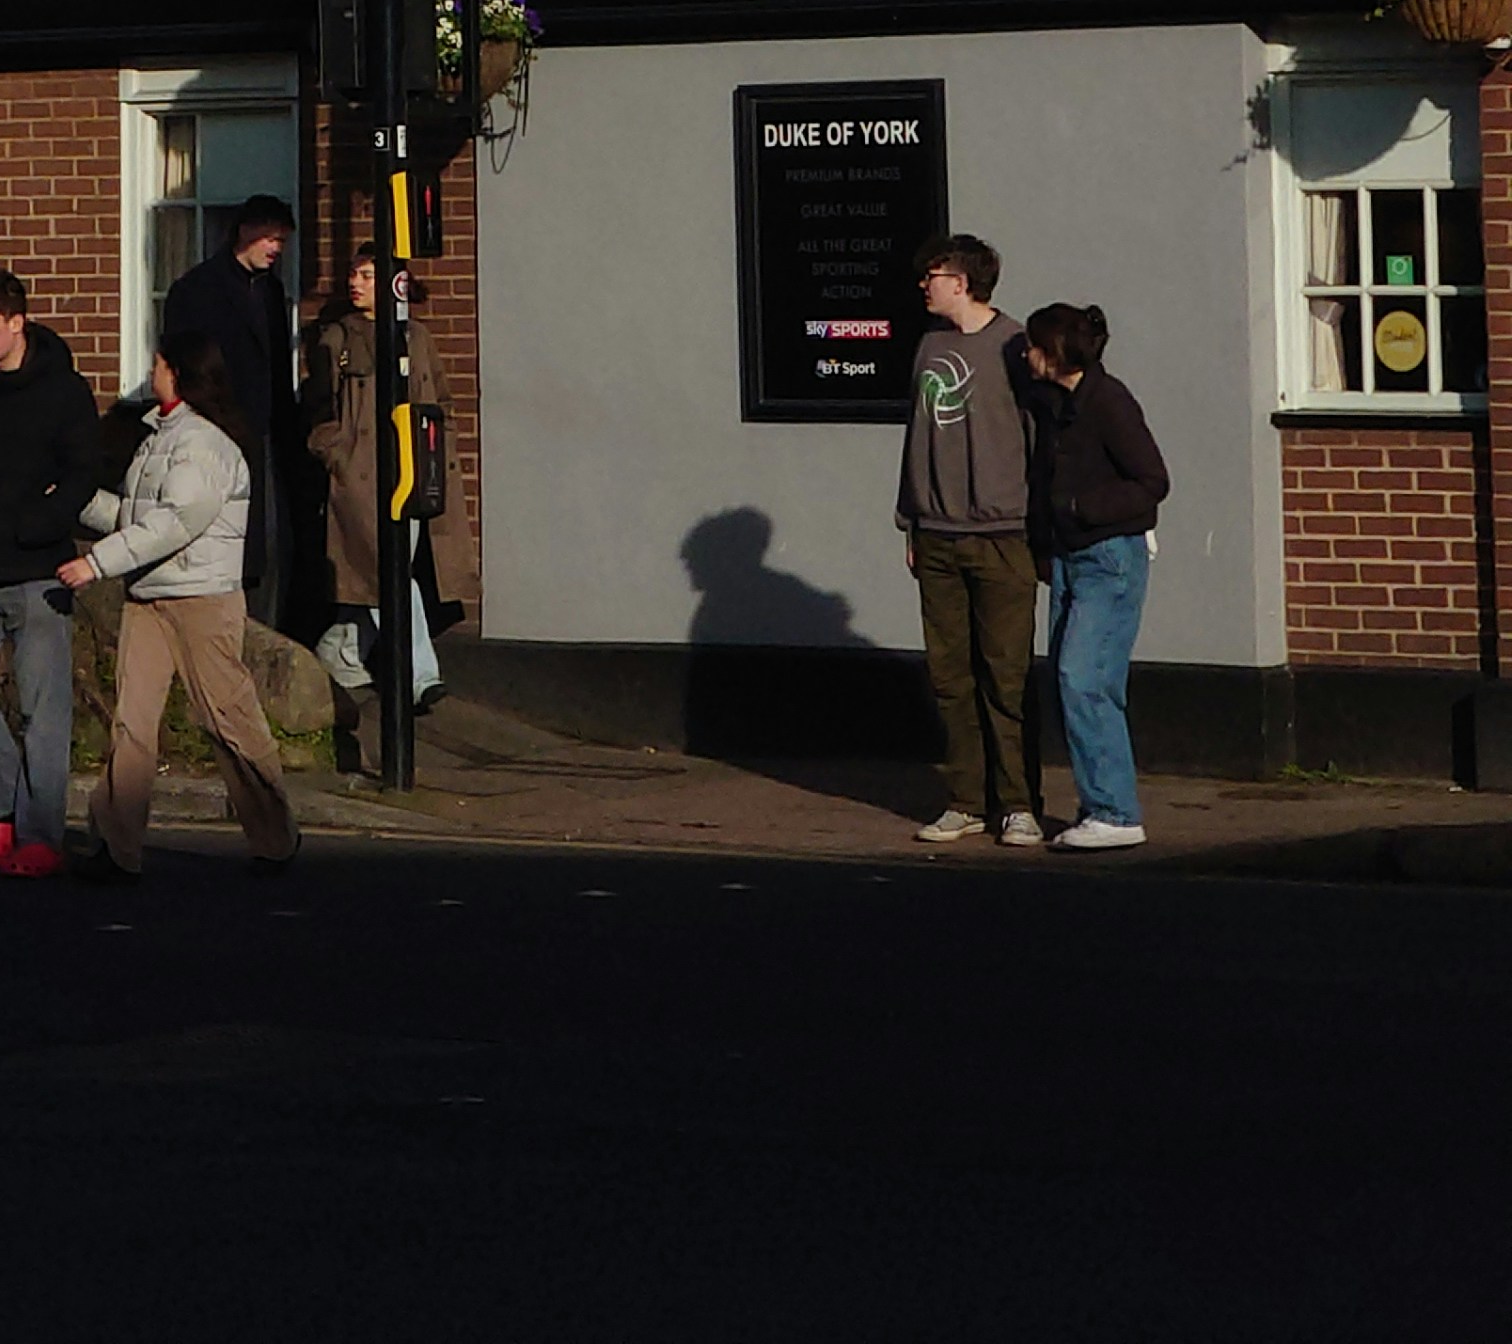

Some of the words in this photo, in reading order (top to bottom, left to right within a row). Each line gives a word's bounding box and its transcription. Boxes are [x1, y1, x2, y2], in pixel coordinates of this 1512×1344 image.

[374, 130, 385, 149] 3
[764, 123, 821, 147] DUKE
[826, 121, 855, 146] OF
[859, 120, 920, 145] YORK
[785, 168, 843, 182] PREMIUM
[848, 167, 901, 181] BRANDS
[800, 203, 842, 218] GREAT
[847, 202, 887, 217] VALUE
[797, 239, 820, 253] ALL
[824, 238, 846, 252] THE
[850, 238, 892, 252] GREAT
[812, 262, 879, 277] SPORTING
[821, 285, 872, 299] ACTION
[806, 322, 828, 339] sky
[831, 322, 889, 338] SPORTS
[822, 362, 841, 375] BT
[842, 361, 876, 377] Sport
